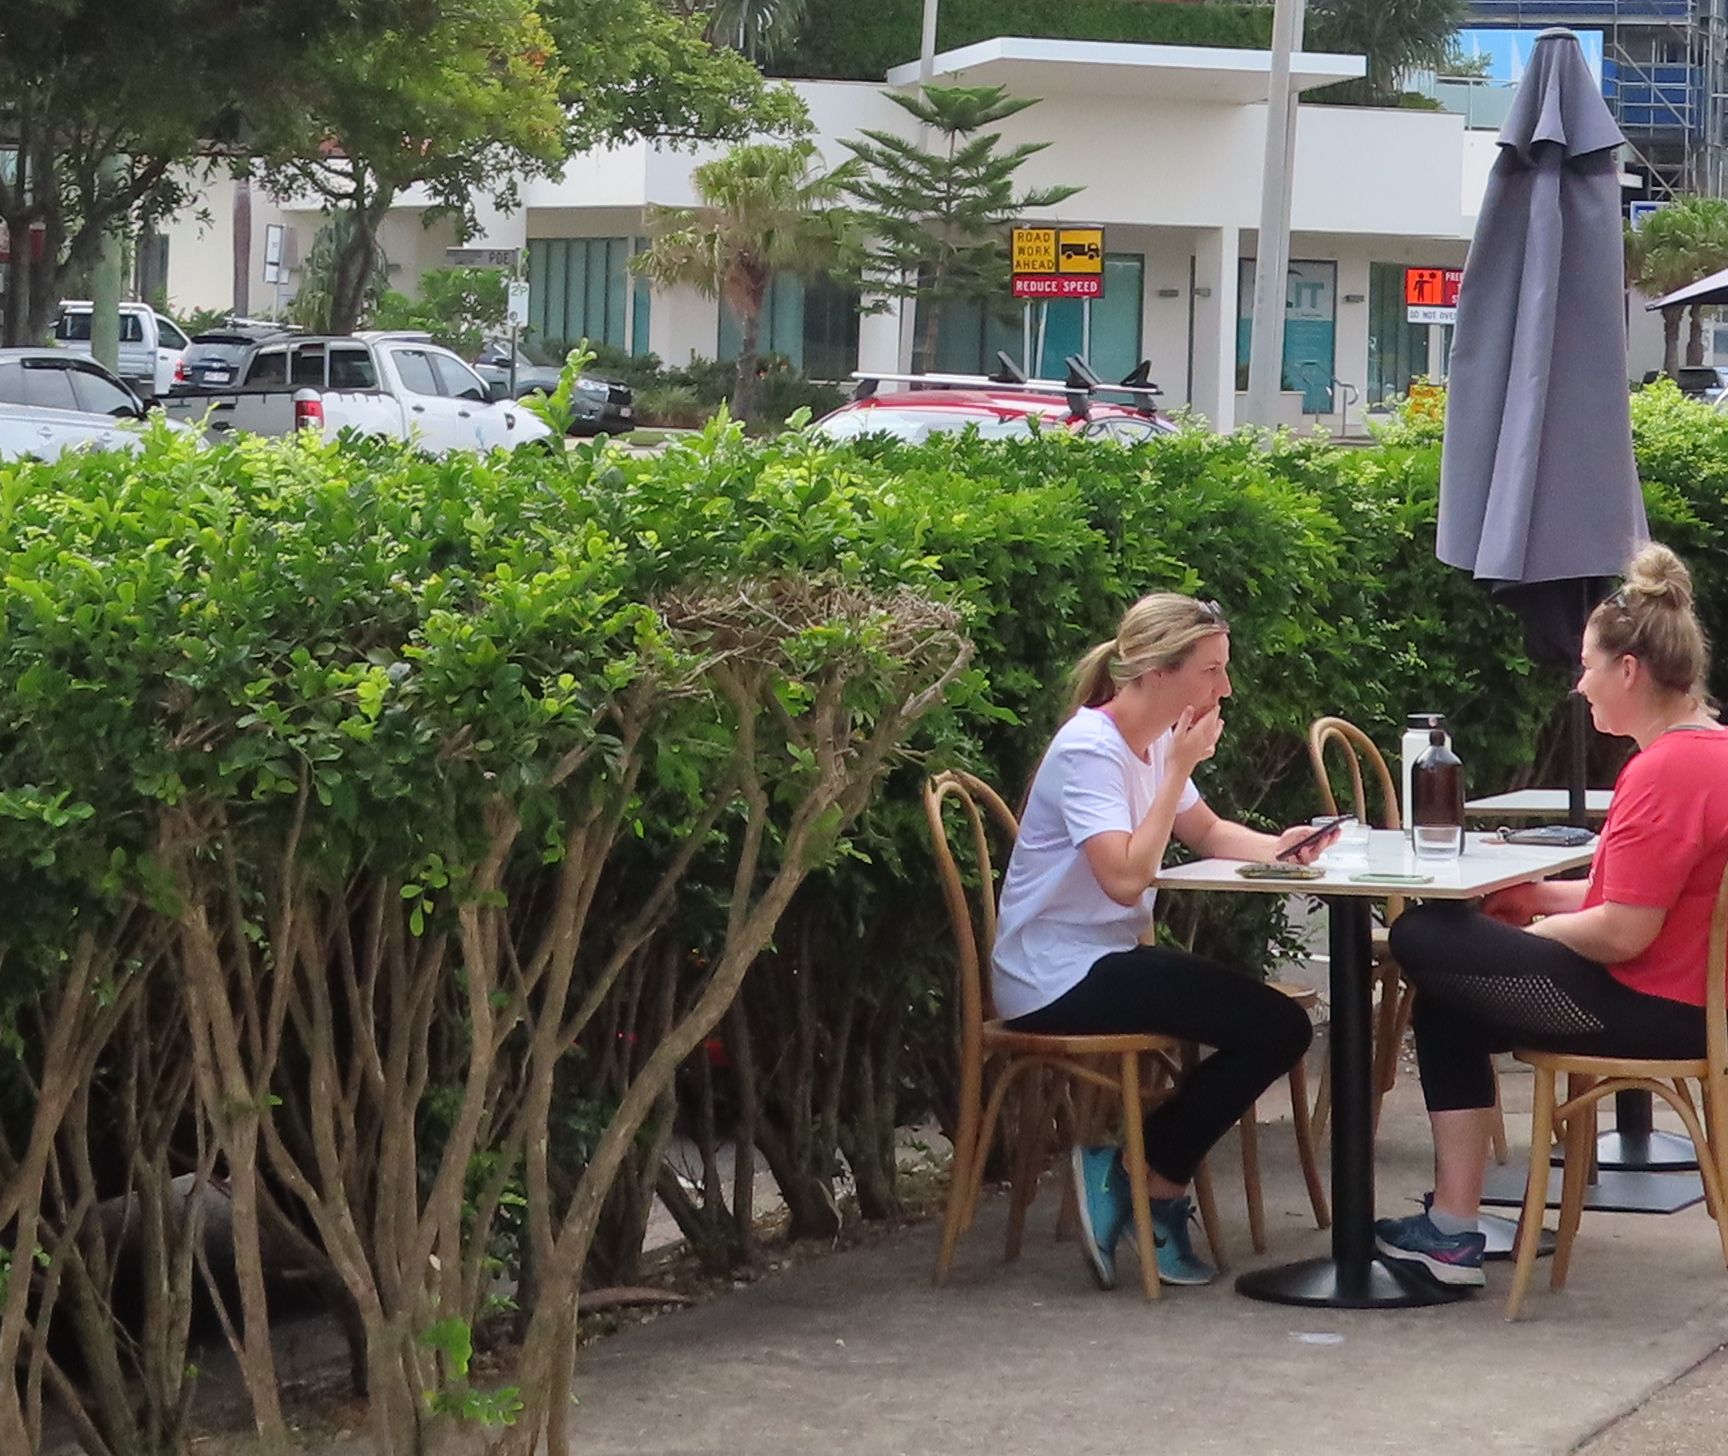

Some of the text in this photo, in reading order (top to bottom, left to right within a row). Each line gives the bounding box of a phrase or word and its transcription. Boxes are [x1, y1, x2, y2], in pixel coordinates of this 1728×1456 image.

[1017, 231, 1050, 243] ROAD
[1017, 246, 1051, 256] WORK
[1015, 259, 1054, 270] AHEAD
[511, 285, 528, 296] 2P
[1015, 280, 1098, 292] REDUCE SPEED
[1409, 310, 1419, 319] DO
[1423, 311, 1436, 320] NOT
